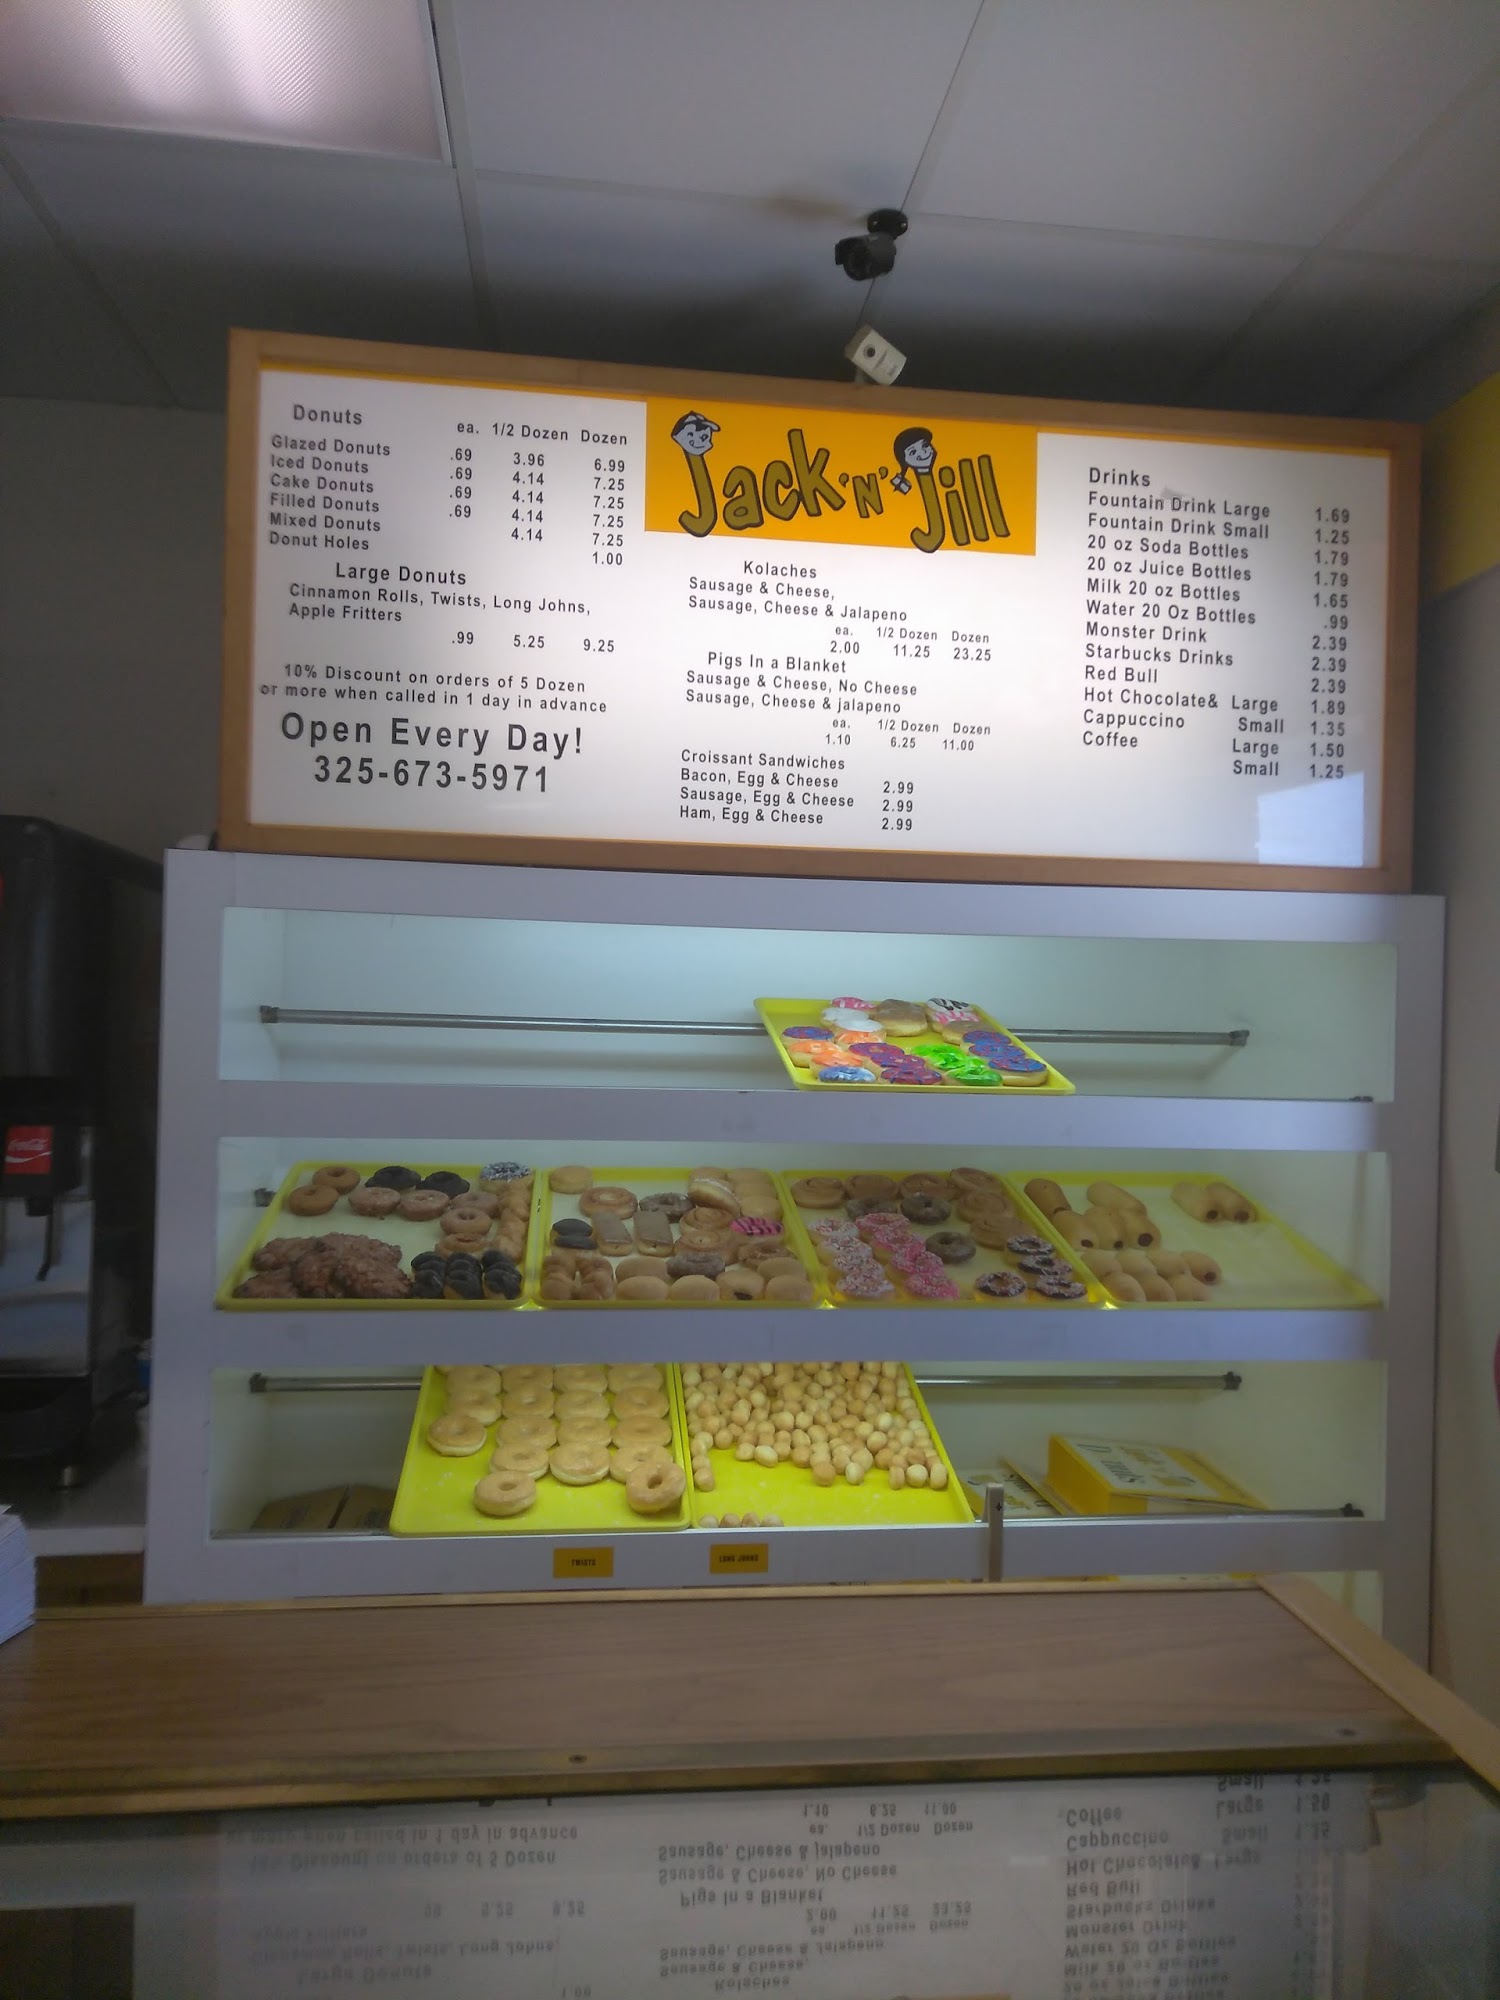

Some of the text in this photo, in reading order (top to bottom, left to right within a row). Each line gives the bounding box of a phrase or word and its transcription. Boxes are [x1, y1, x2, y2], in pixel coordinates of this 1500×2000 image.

[293, 404, 362, 425] Donuts
[457, 422, 627, 445] ea. 1/2 Dozen Dozen
[271, 434, 625, 473] Glazed Donuts .69 3.96 6.99
[271, 454, 625, 491] Iced Donuts .69 4.14 7.25
[1089, 467, 1150, 487] Drinks
[270, 473, 624, 510] Cake Donuts .69 4.14 7.25
[678, 428, 846, 538] Jack
[910, 454, 1011, 553] Jill
[270, 492, 624, 528] Filled Donuts .69 4.14 7.25
[1089, 490, 1270, 521] Fountain Drink Large
[270, 512, 623, 547] Mixed Donuts 4.14 7.25
[1088, 512, 1269, 539] Fountain Drink Small
[269, 531, 623, 566] Donut Holes 1.00
[1088, 534, 1248, 559] 20 oz Soda Bottles
[336, 562, 466, 585] Large Donuts
[744, 560, 817, 579] Kolaches
[1087, 556, 1251, 581] 20 oz Juice Bottles
[290, 583, 590, 616] Cinnamon Rolls, Twists, Long Johns,
[689, 576, 834, 600] Sausage & Cheese,
[1087, 577, 1240, 602] Milk 20 oz Bottles
[289, 602, 402, 622] Apple Fritters
[689, 595, 907, 623] Sausage, Cheese & Jalapeno
[1086, 599, 1256, 624] Water 20 Oz Bottles
[452, 631, 614, 653] .99 5.25 9.25
[1086, 621, 1206, 643] Monster Drink
[708, 651, 846, 673] Pigs In a Blanket
[1085, 643, 1233, 666] Starbucks Drinks
[285, 664, 585, 692] 10% Discount on orders of 5 Dozen
[687, 670, 917, 696] Sausage & Cheese, No Cheese
[1085, 665, 1157, 683] Red Bull
[259, 684, 606, 713] or more when called in 1 day in advance
[686, 689, 901, 715] Sausage, Cheese & jalapeno
[1084, 686, 1113, 703] Hot
[1232, 695, 1278, 715] Large
[1084, 708, 1284, 733] Cappuccino Small
[282, 712, 581, 760] Open Every Day!
[1083, 730, 1279, 758] Coffee Large
[681, 749, 845, 770] Croissant Sandwiches
[1233, 759, 1279, 776] Small
[315, 755, 546, 793] 325-673-5971
[681, 767, 914, 795] Bacon, Egg & Cheese 2.99
[680, 786, 913, 813] Sausage, Egg & Cheese 2.99
[680, 805, 912, 831] Ham, Egg & Cheese 2.99
